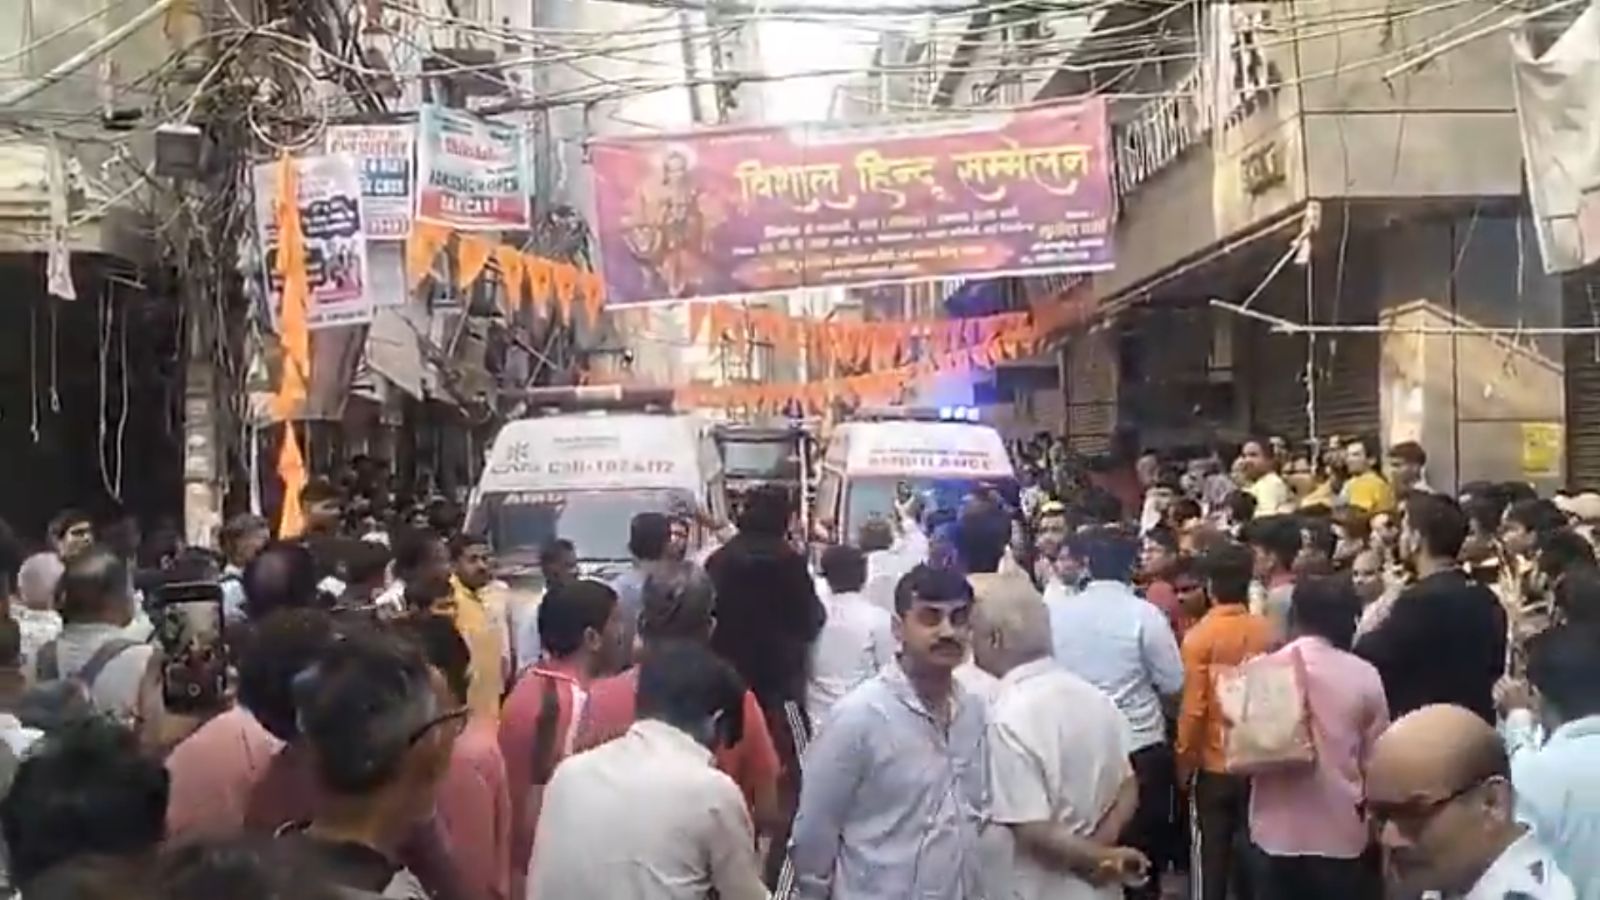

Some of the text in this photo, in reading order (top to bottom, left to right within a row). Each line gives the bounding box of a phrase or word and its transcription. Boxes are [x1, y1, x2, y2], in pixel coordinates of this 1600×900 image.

[735, 159, 856, 213] विशाल
[951, 137, 1093, 202] सम्मेलन
[868, 456, 992, 471] AMBULANCE
